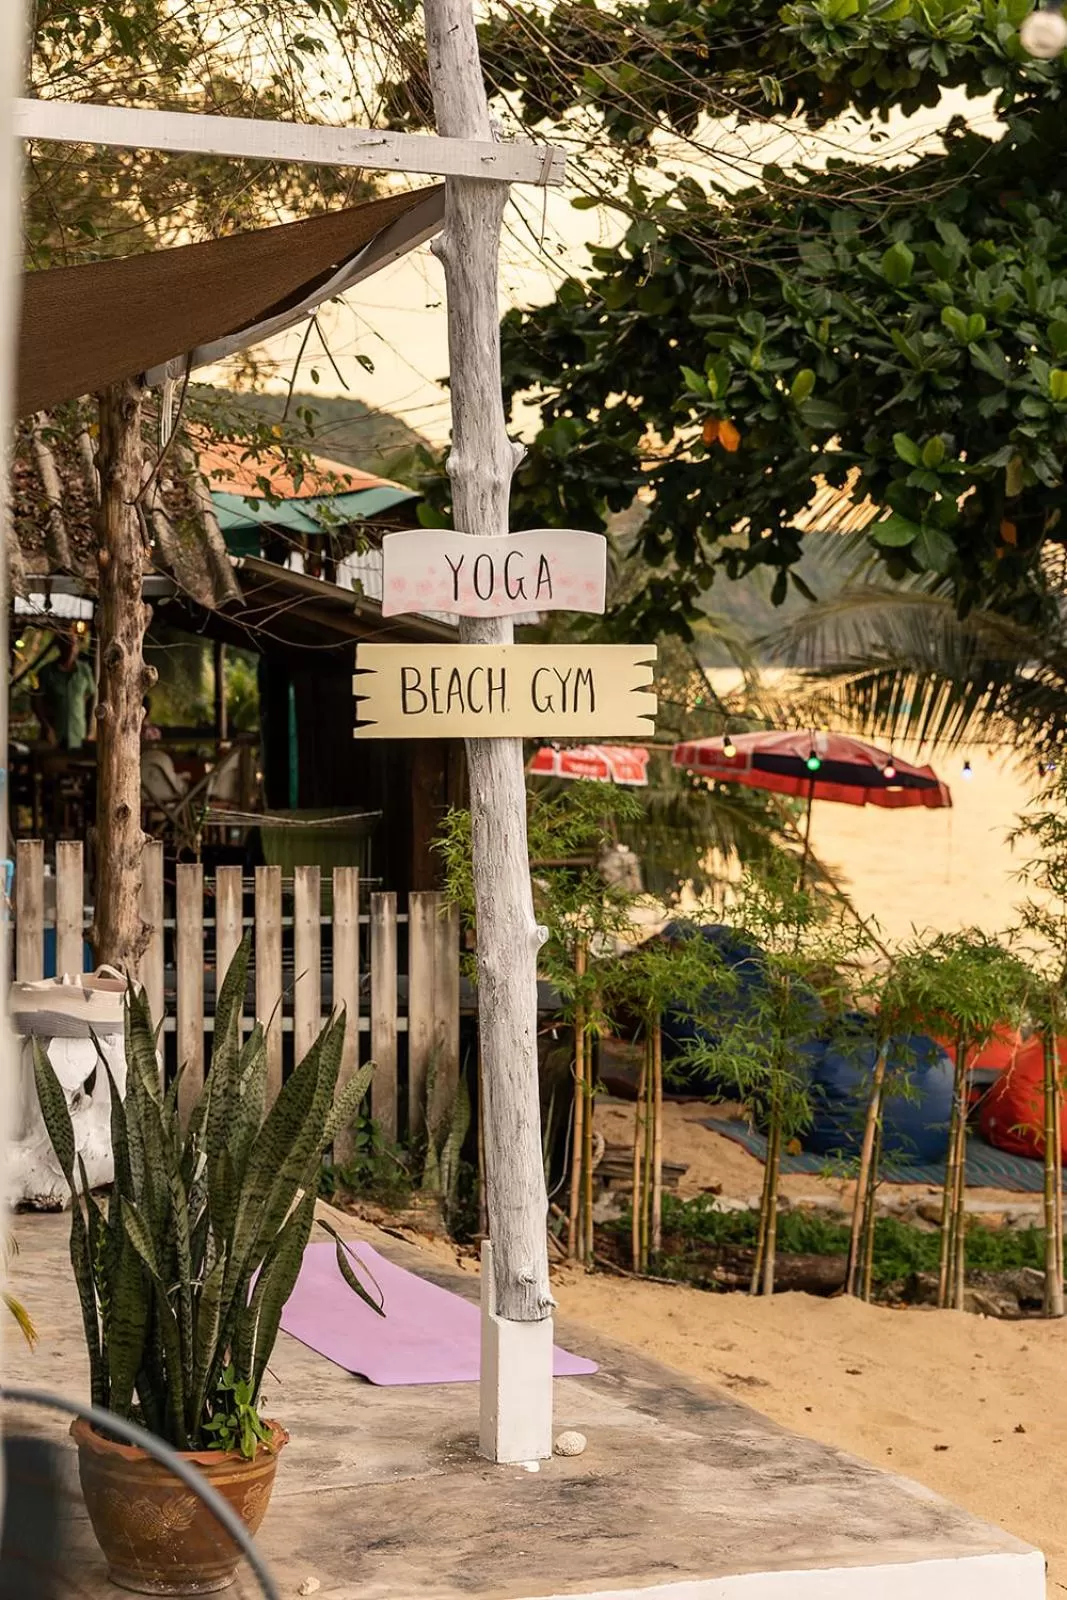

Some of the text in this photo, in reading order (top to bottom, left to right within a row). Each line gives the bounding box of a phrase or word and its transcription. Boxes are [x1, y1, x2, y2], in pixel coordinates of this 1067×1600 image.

[444, 551, 553, 601] YOGA
[401, 667, 595, 714] BEACH GYM
